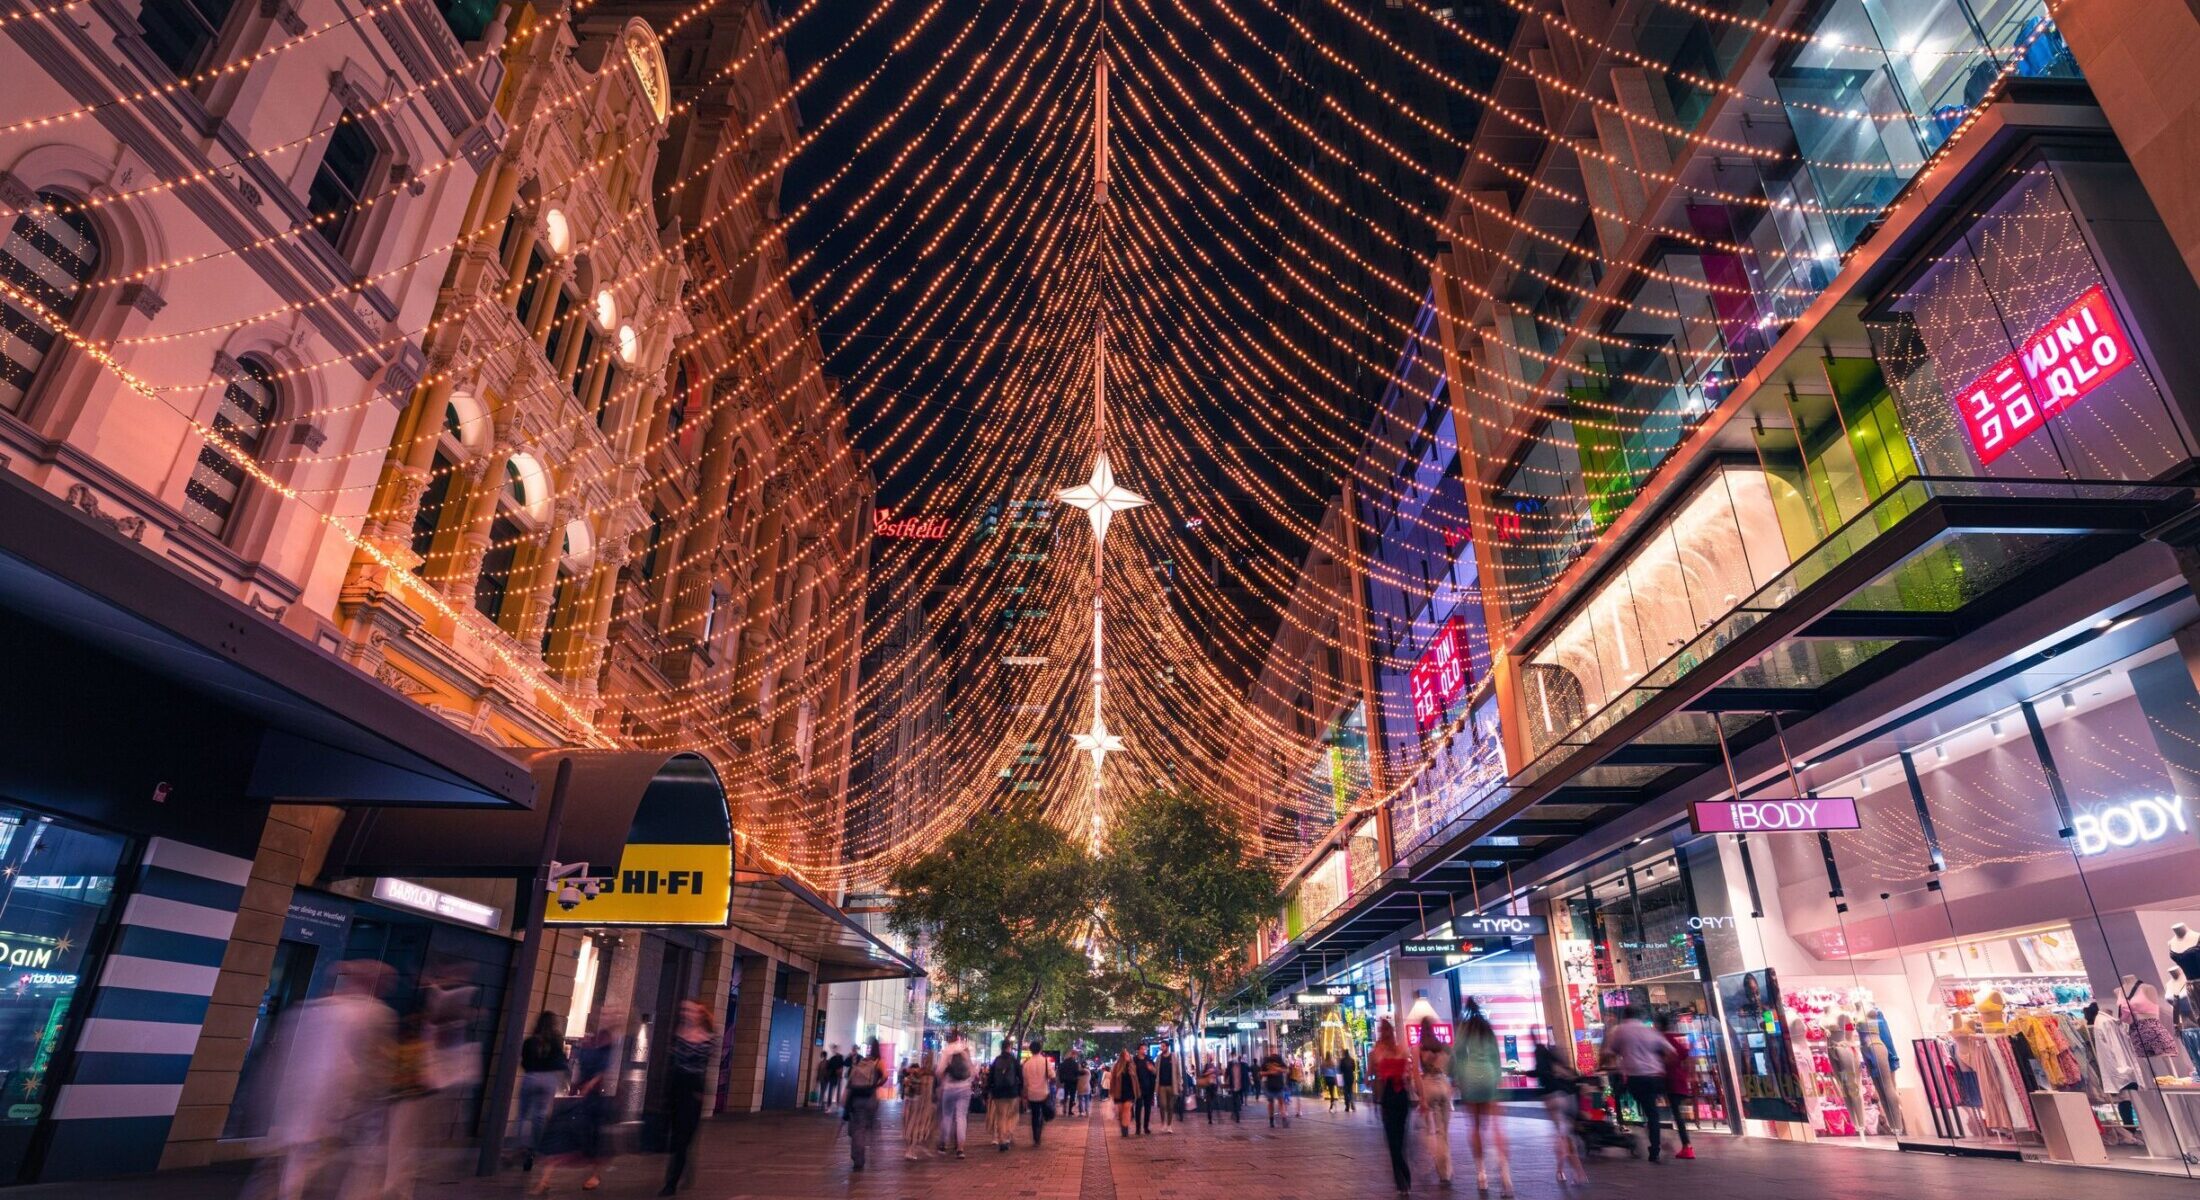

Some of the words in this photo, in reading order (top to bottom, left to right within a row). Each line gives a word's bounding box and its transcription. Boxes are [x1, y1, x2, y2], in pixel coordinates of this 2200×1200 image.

[2038, 308, 2097, 367] UNI
[2049, 336, 2117, 399] QLO
[874, 508, 950, 538] Westfield
[1436, 631, 1455, 668] UNI
[1440, 658, 1460, 698] QLO
[1738, 802, 1818, 829] BODY
[2073, 795, 2187, 855] BODY
[389, 881, 438, 909] BABYLON
[323, 912, 346, 921] Westfield
[1480, 919, 1523, 932] TYPO
[1327, 986, 1350, 995] rebel
